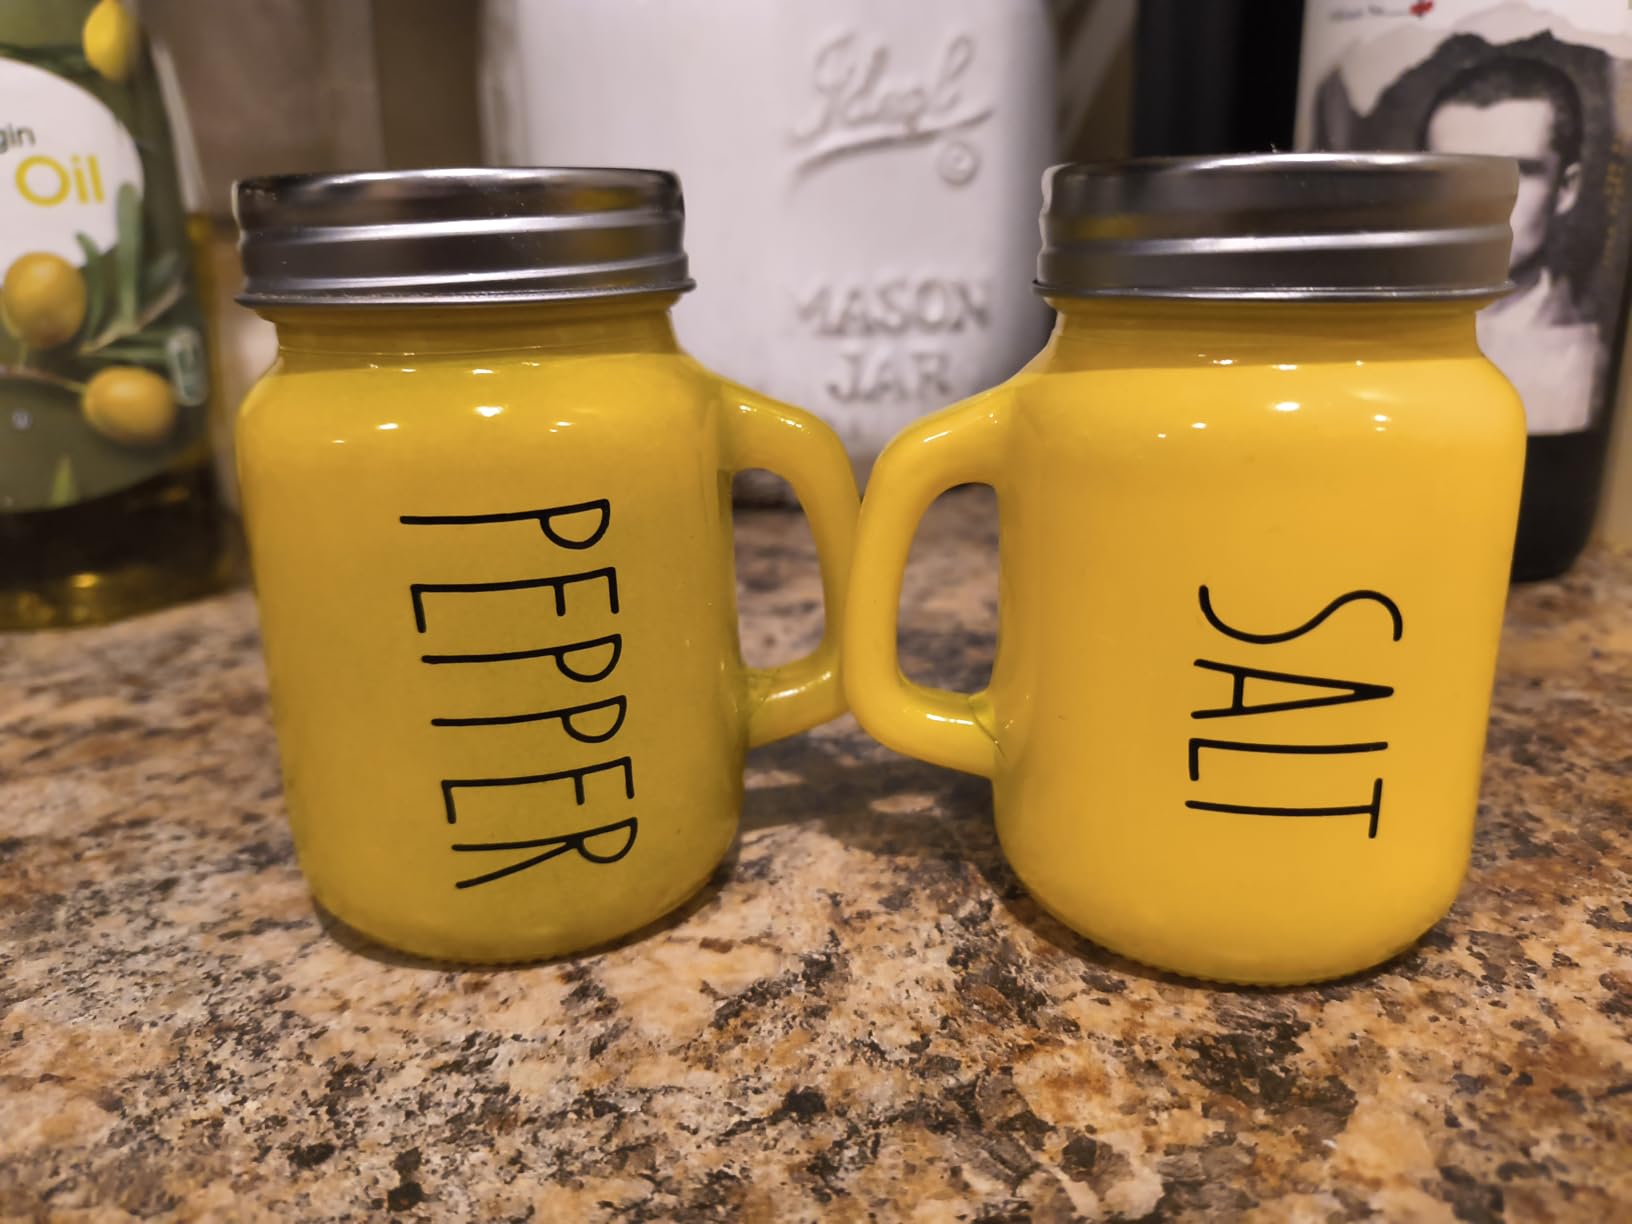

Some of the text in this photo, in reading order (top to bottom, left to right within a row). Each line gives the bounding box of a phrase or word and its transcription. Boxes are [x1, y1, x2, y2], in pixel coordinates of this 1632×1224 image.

[15, 154, 105, 207] Oil
[796, 275, 990, 338] MASON
[826, 350, 953, 402] JAR
[399, 498, 638, 889] PEPPER
[1185, 584, 1403, 839] SALT
